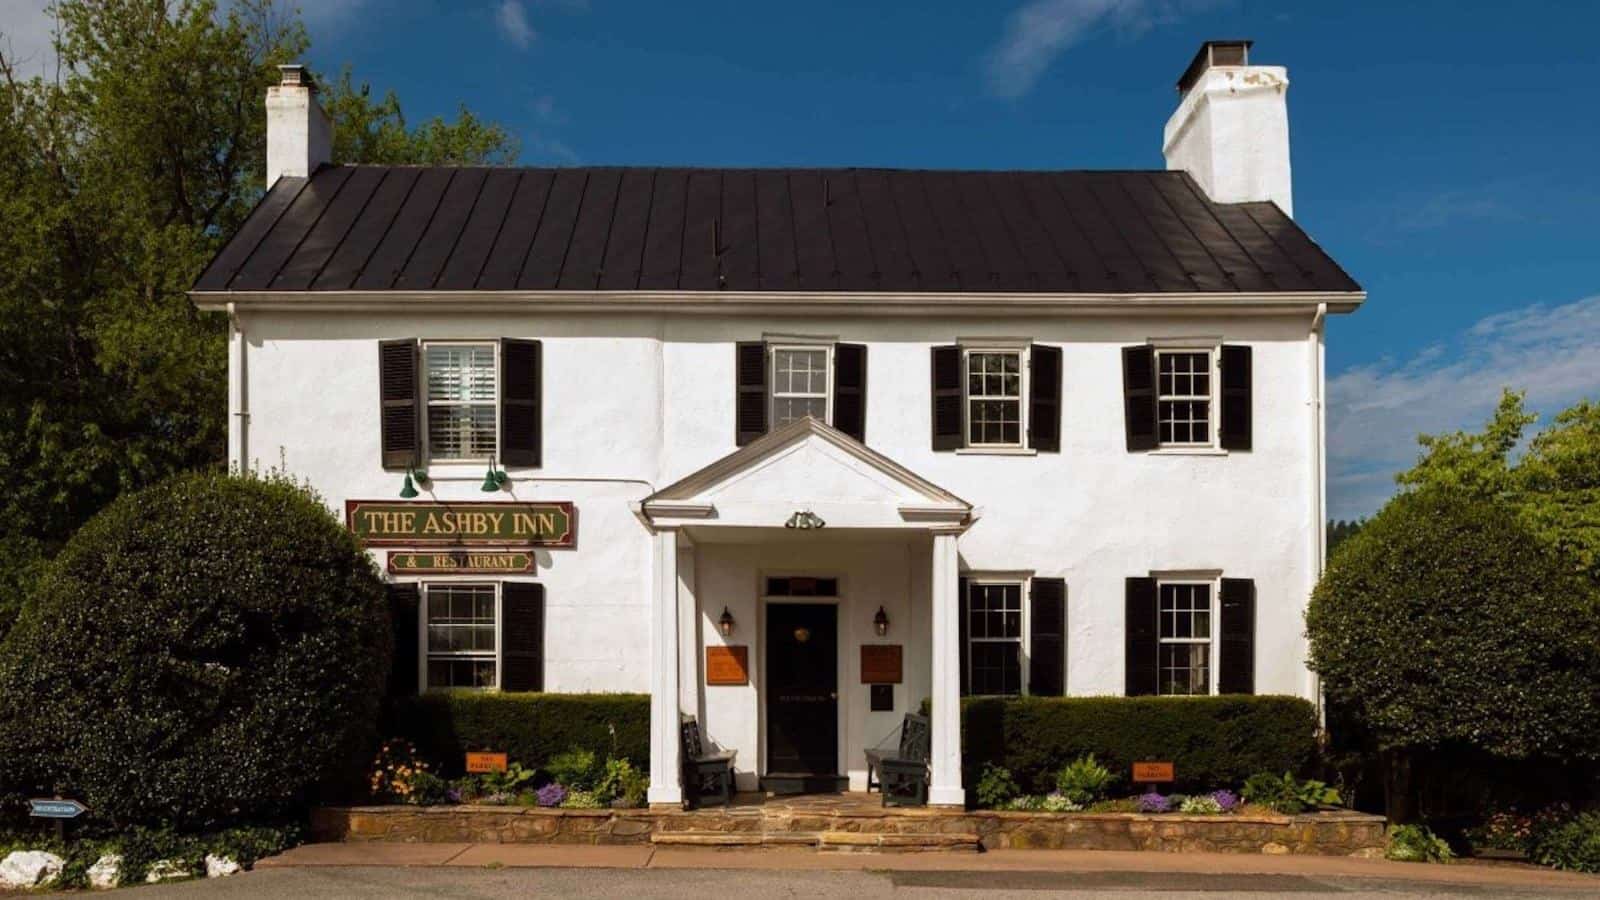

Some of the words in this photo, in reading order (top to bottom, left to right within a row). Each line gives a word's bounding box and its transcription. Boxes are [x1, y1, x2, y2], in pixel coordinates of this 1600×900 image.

[364, 511, 416, 534] THE
[422, 512, 504, 534] ASHBY
[512, 512, 555, 535] INN
[406, 555, 417, 568] &
[433, 555, 515, 568] RESTAURANT
